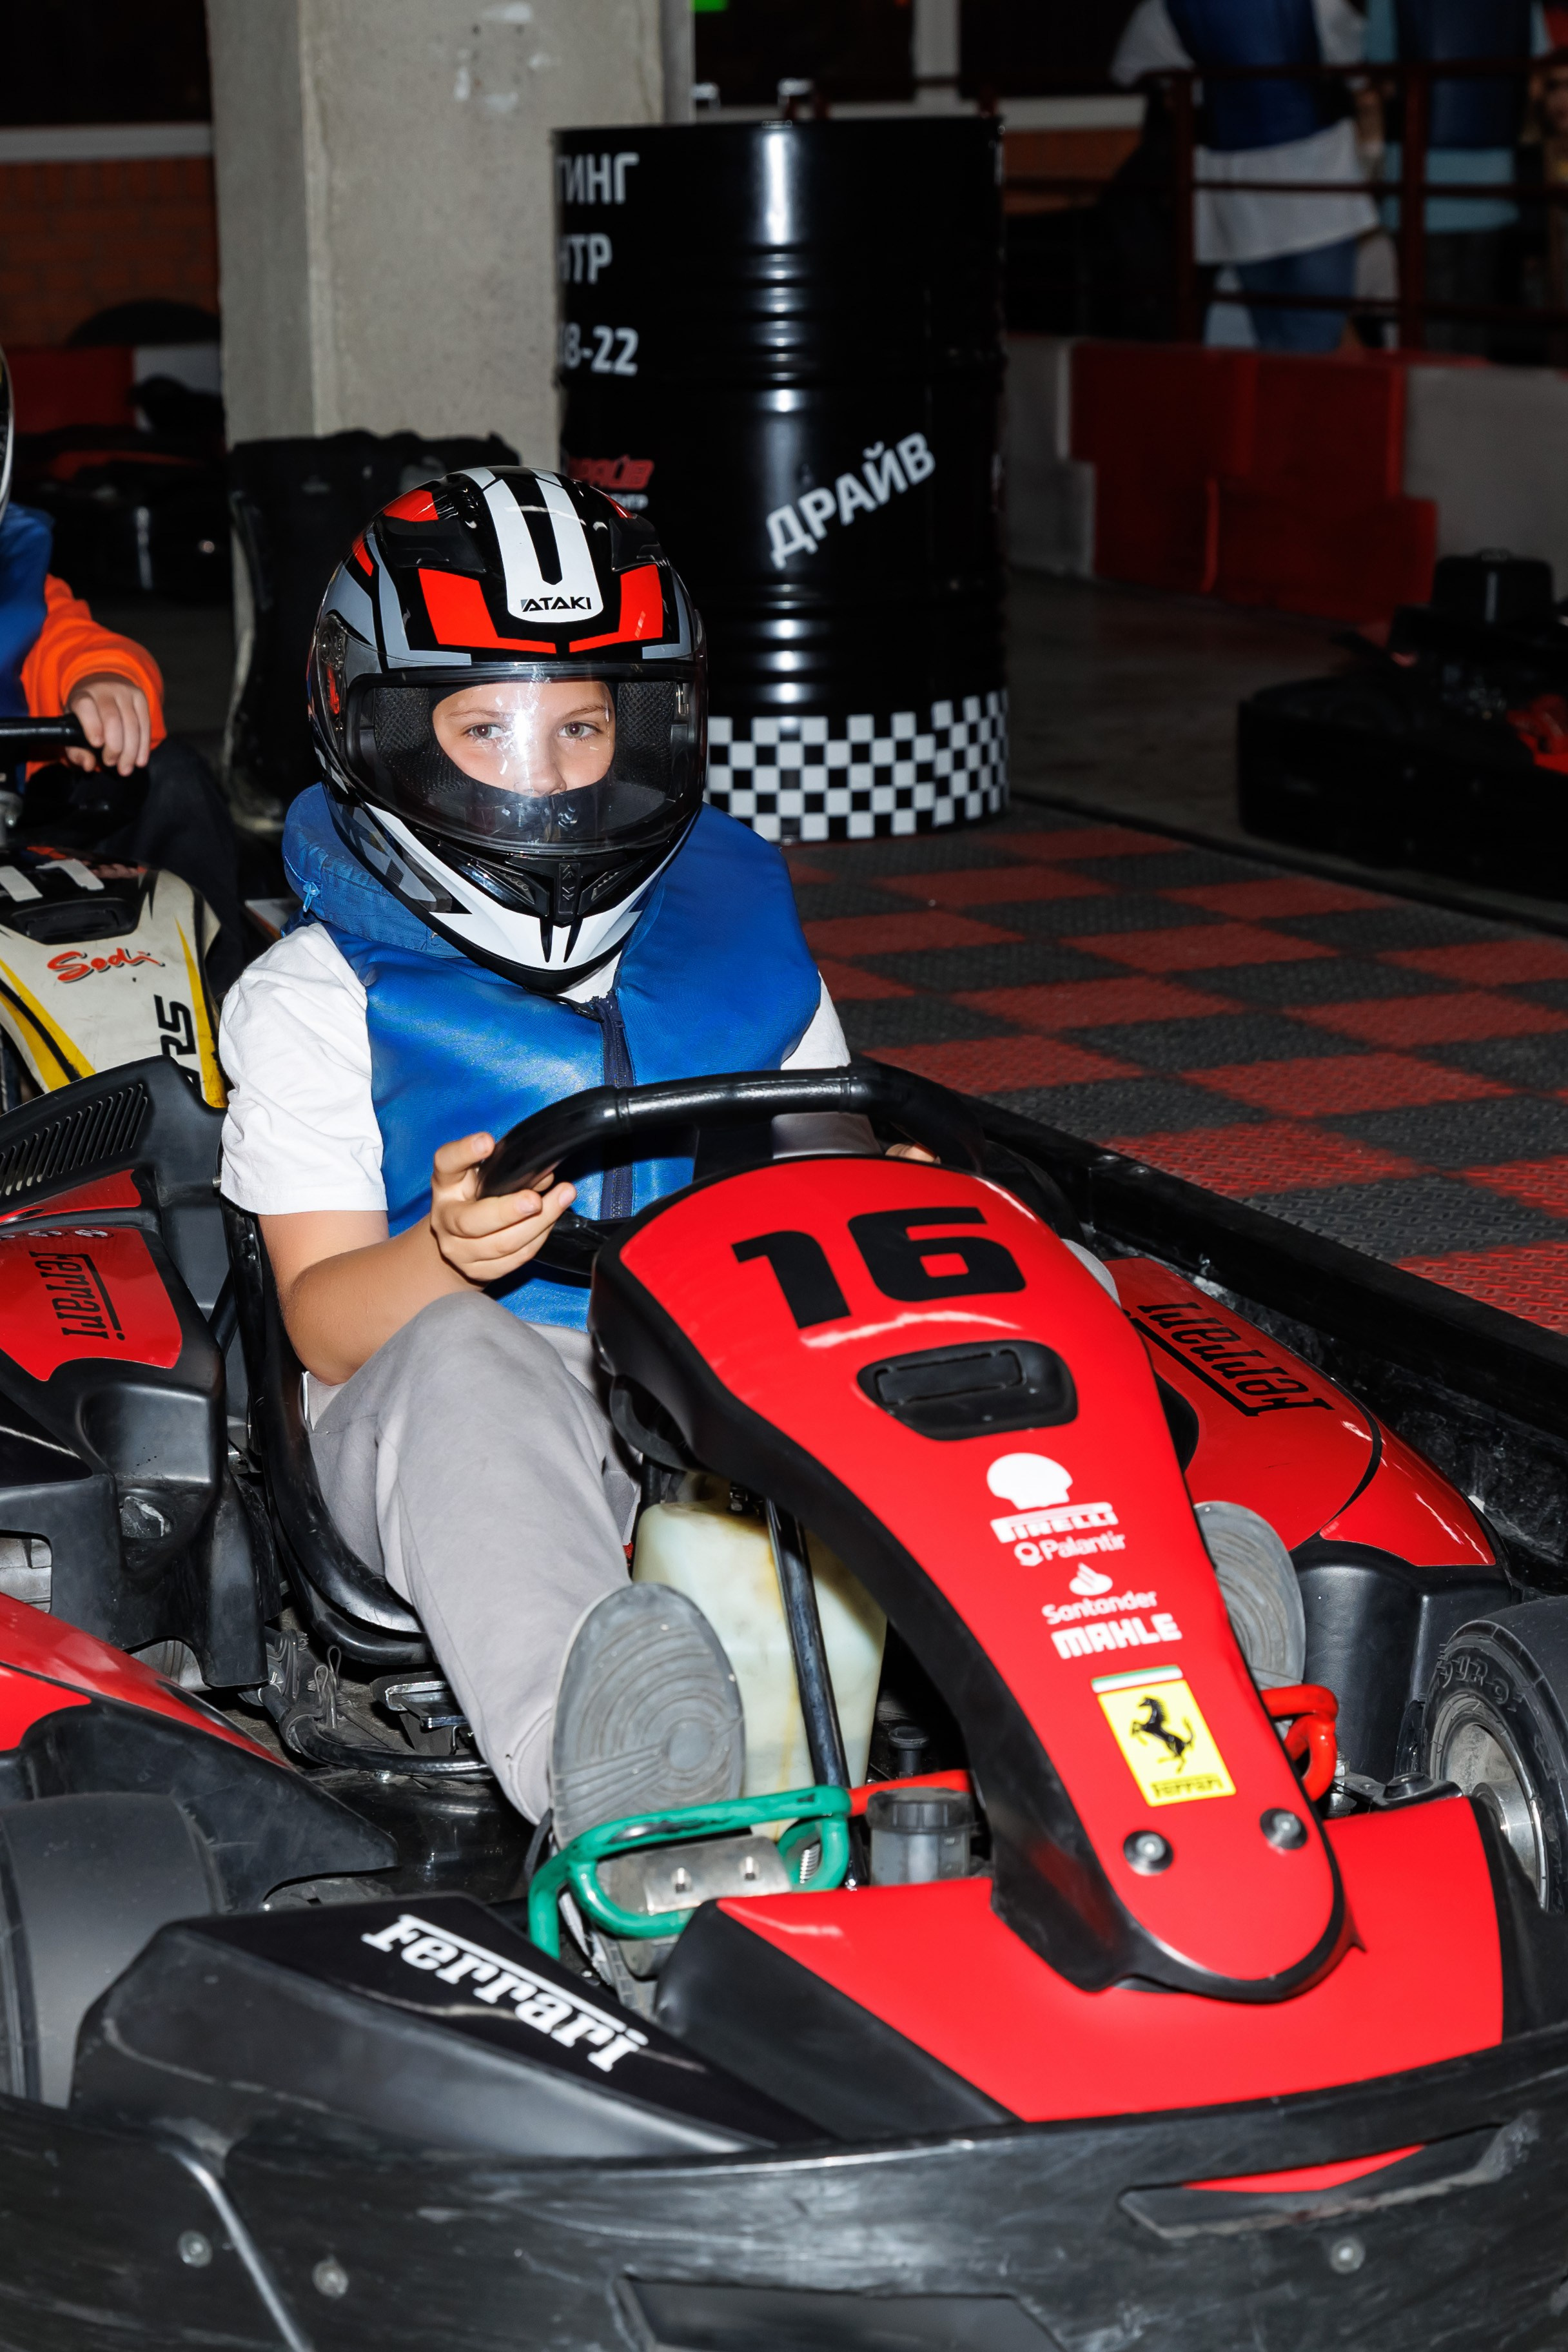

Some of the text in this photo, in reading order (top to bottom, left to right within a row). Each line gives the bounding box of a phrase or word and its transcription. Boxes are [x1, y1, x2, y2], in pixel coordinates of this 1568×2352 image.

[561, 322, 639, 377] 8-22
[766, 432, 936, 570] ДРАЙВ
[520, 596, 592, 612] ATAKI
[47, 948, 165, 983] Sodi
[730, 1206, 1026, 1329] 16
[29, 1251, 125, 1341] Ferrari
[1122, 1302, 1335, 1416] Ferrari
[990, 1502, 1119, 1544] PIRELLI
[1039, 1531, 1126, 1560] Palantir
[1042, 1590, 1157, 1625] Santander
[1051, 1613, 1182, 1660] MAHLE
[361, 1914, 649, 2073] Ferrari
